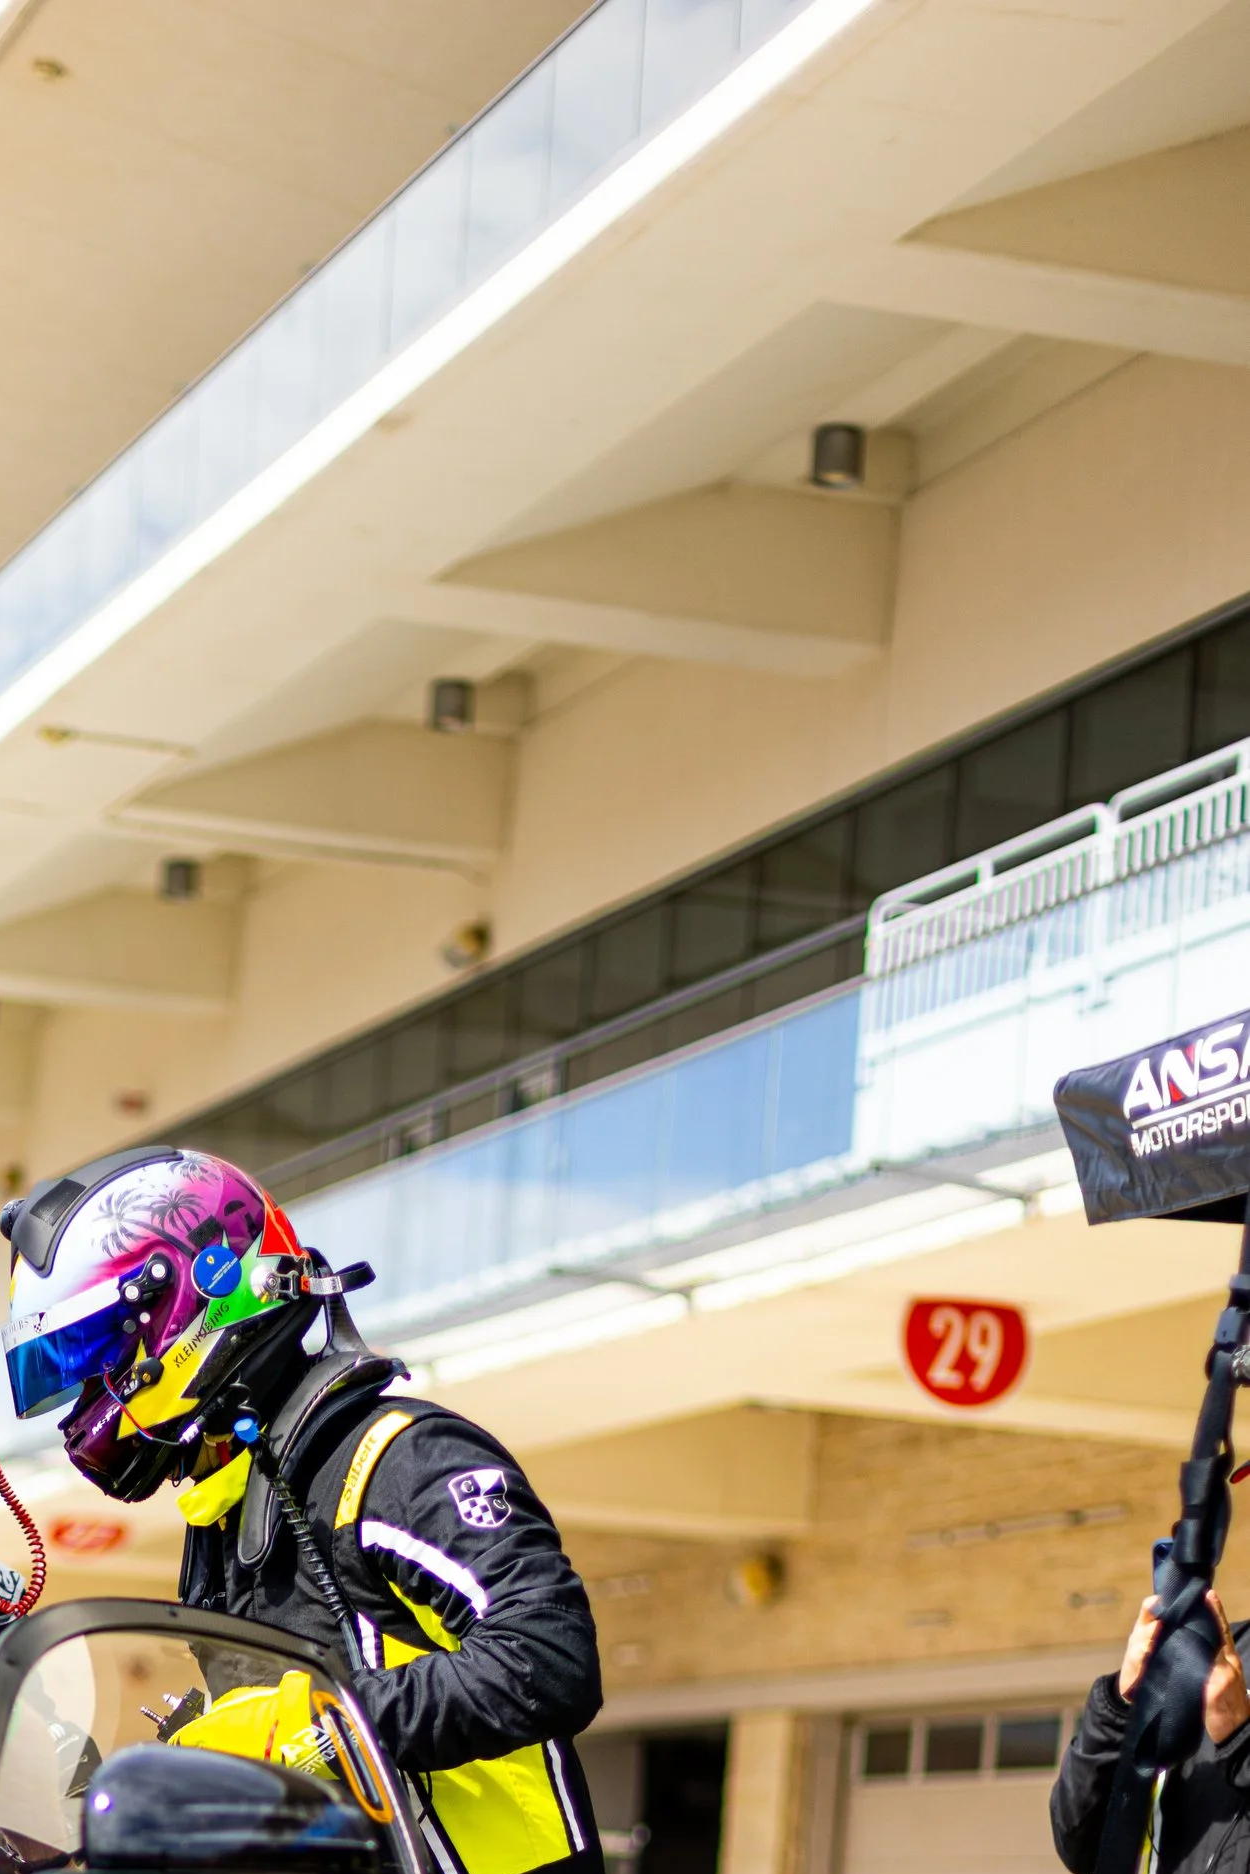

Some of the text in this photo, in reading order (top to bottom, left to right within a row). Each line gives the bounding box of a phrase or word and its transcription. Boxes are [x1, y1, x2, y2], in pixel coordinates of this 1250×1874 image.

[1123, 1022, 1250, 1120] ANS
[1130, 1093, 1250, 1158] MOTORSPO
[926, 1305, 1004, 1393] 29
